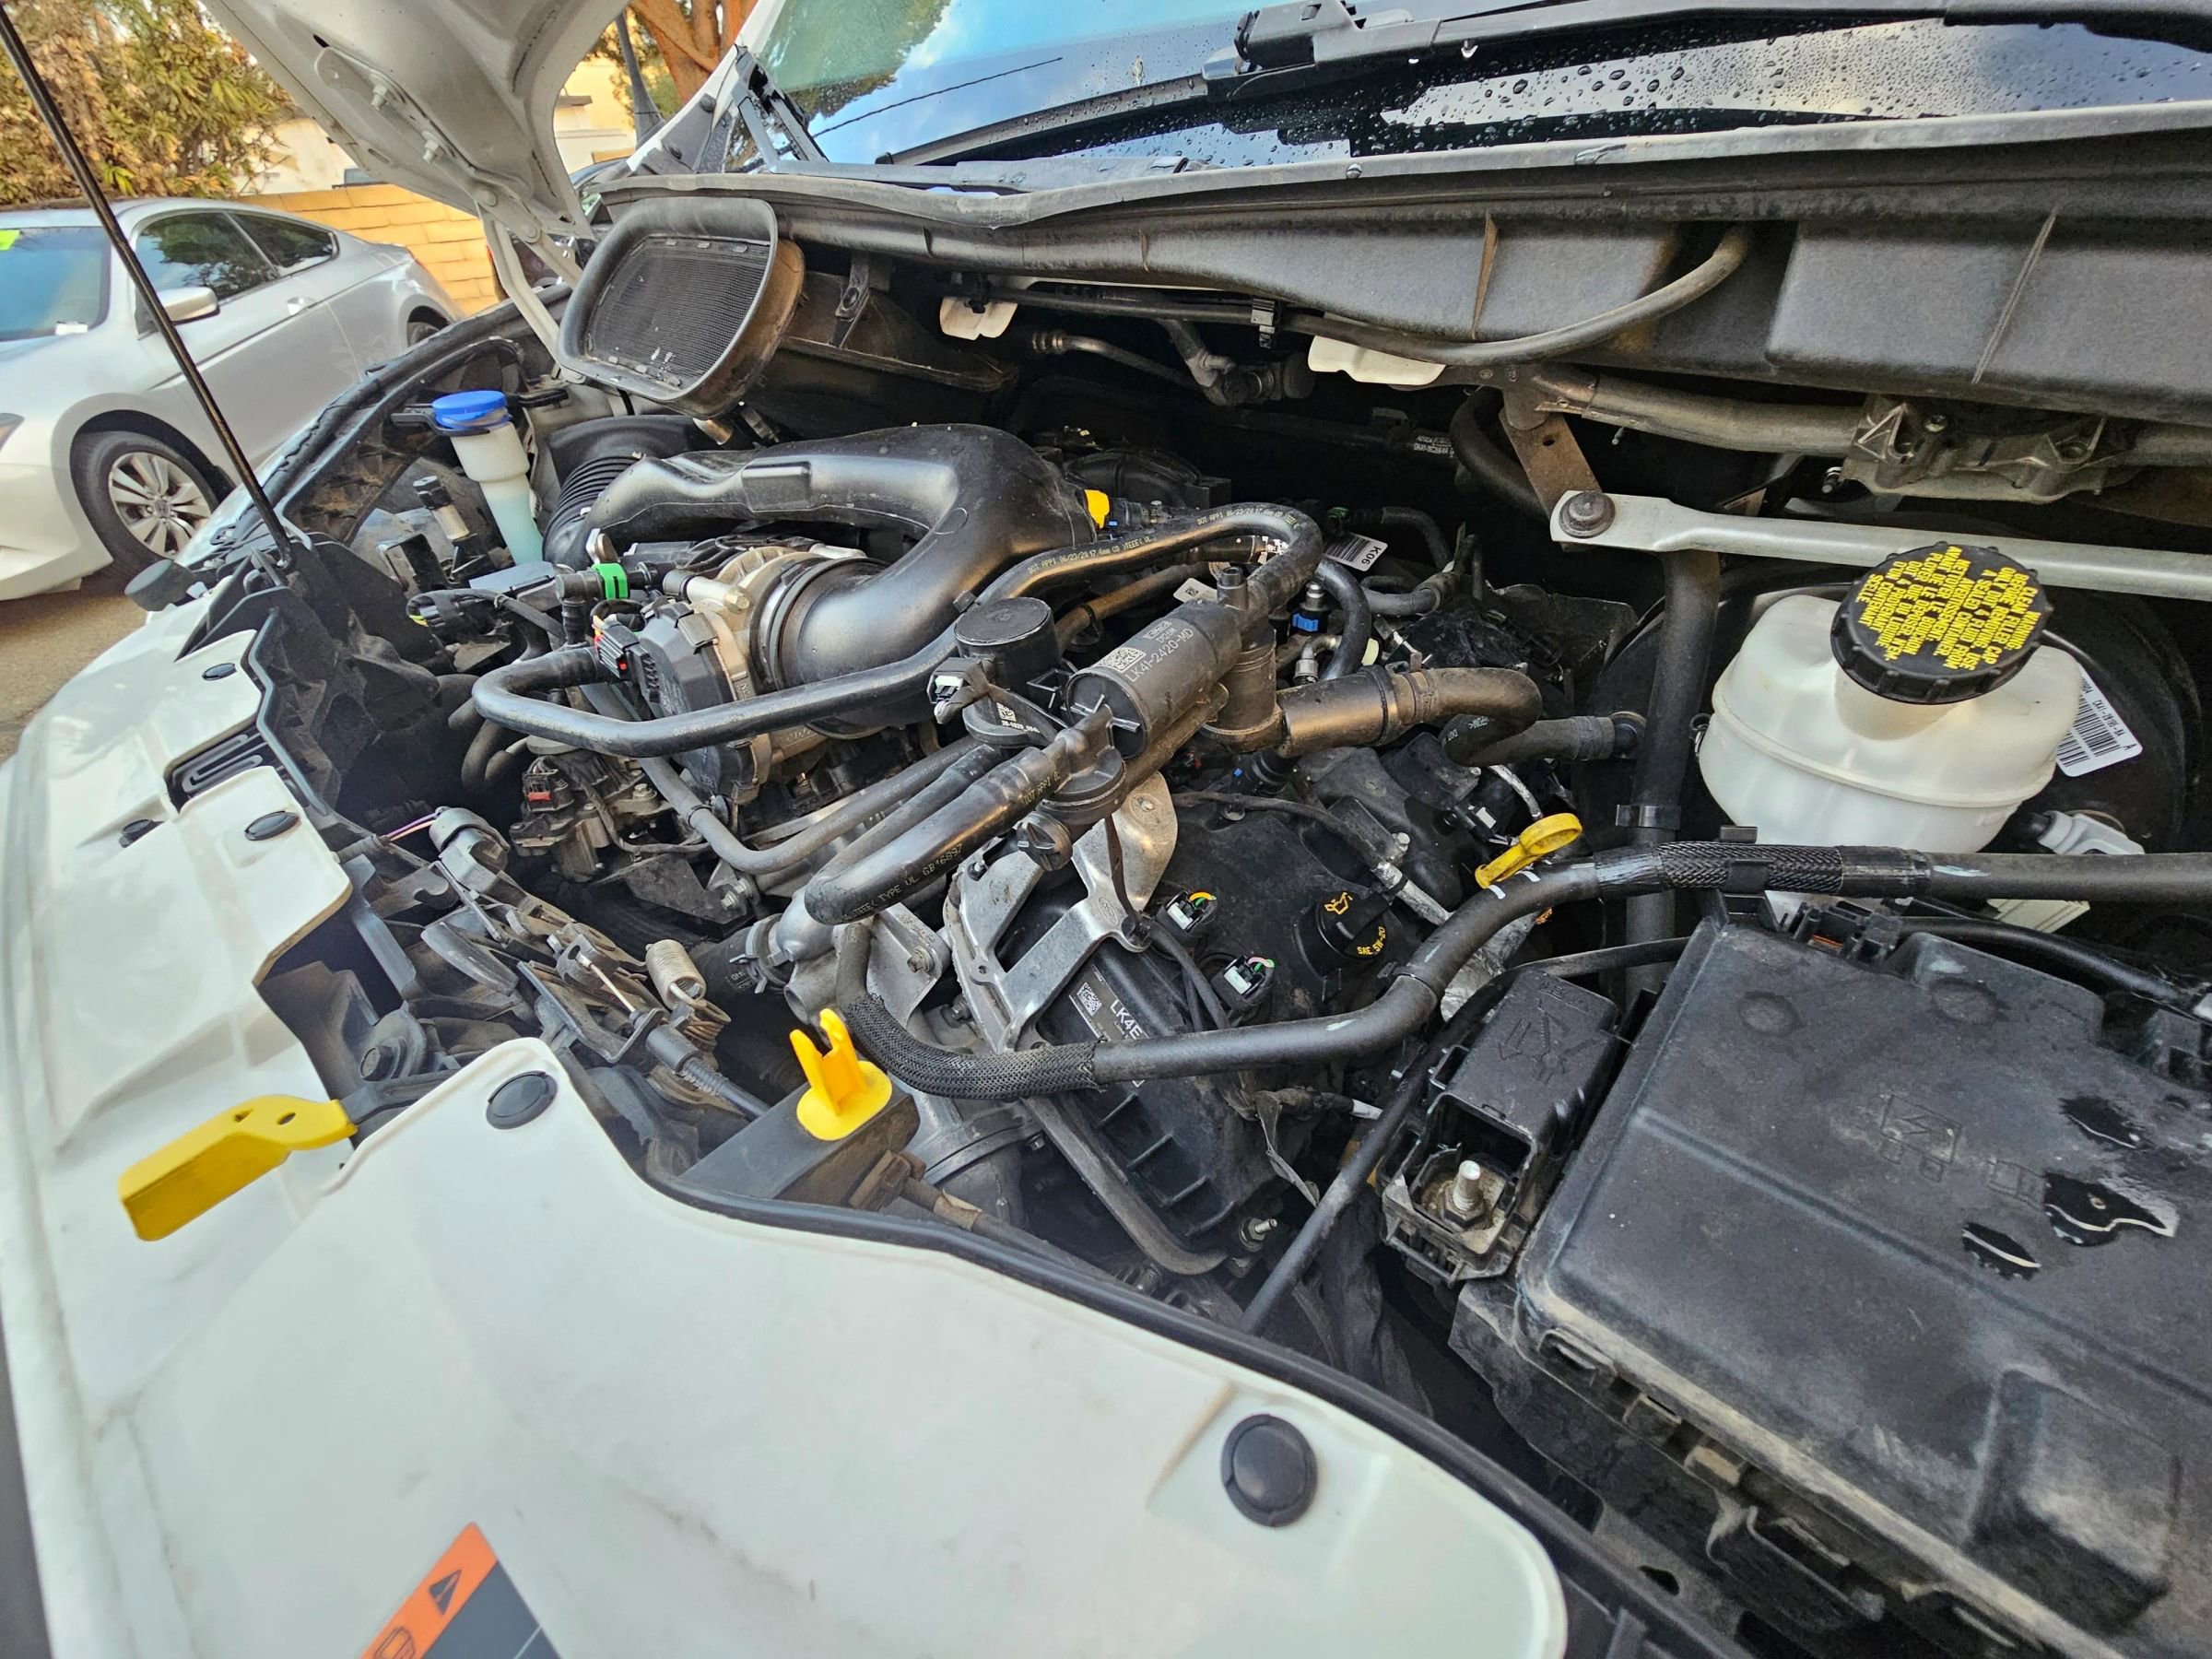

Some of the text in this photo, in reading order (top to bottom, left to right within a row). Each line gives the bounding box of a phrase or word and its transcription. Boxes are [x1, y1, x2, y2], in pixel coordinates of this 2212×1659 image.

[1361, 546, 1382, 565] K06
[1903, 560, 1924, 577] DOT
[1936, 546, 1962, 572] AVANT
[1920, 586, 1938, 598] LE
[1928, 573, 1947, 585] DE
[1963, 579, 1992, 609] SEALED
[1997, 572, 2030, 605] BEFORE
[1858, 581, 1894, 627] CONTENANT
[1869, 586, 1907, 633] PROVENANT
[1874, 552, 1944, 649] PLOYER QUE DU LIQUIDE
[1901, 559, 1971, 655] NETTOYER LE BOUCHON
[1942, 567, 2017, 669] ONLY DOT 4 FLUID FROM
[1982, 586, 2038, 664] CLEAN FILLER CAP
[1124, 628, 1194, 682] LK41-2420-MD
[1959, 653, 1982, 670] USE
[877, 884, 902, 901] TYPE
[1357, 925, 1386, 956] SAE 5W-20
